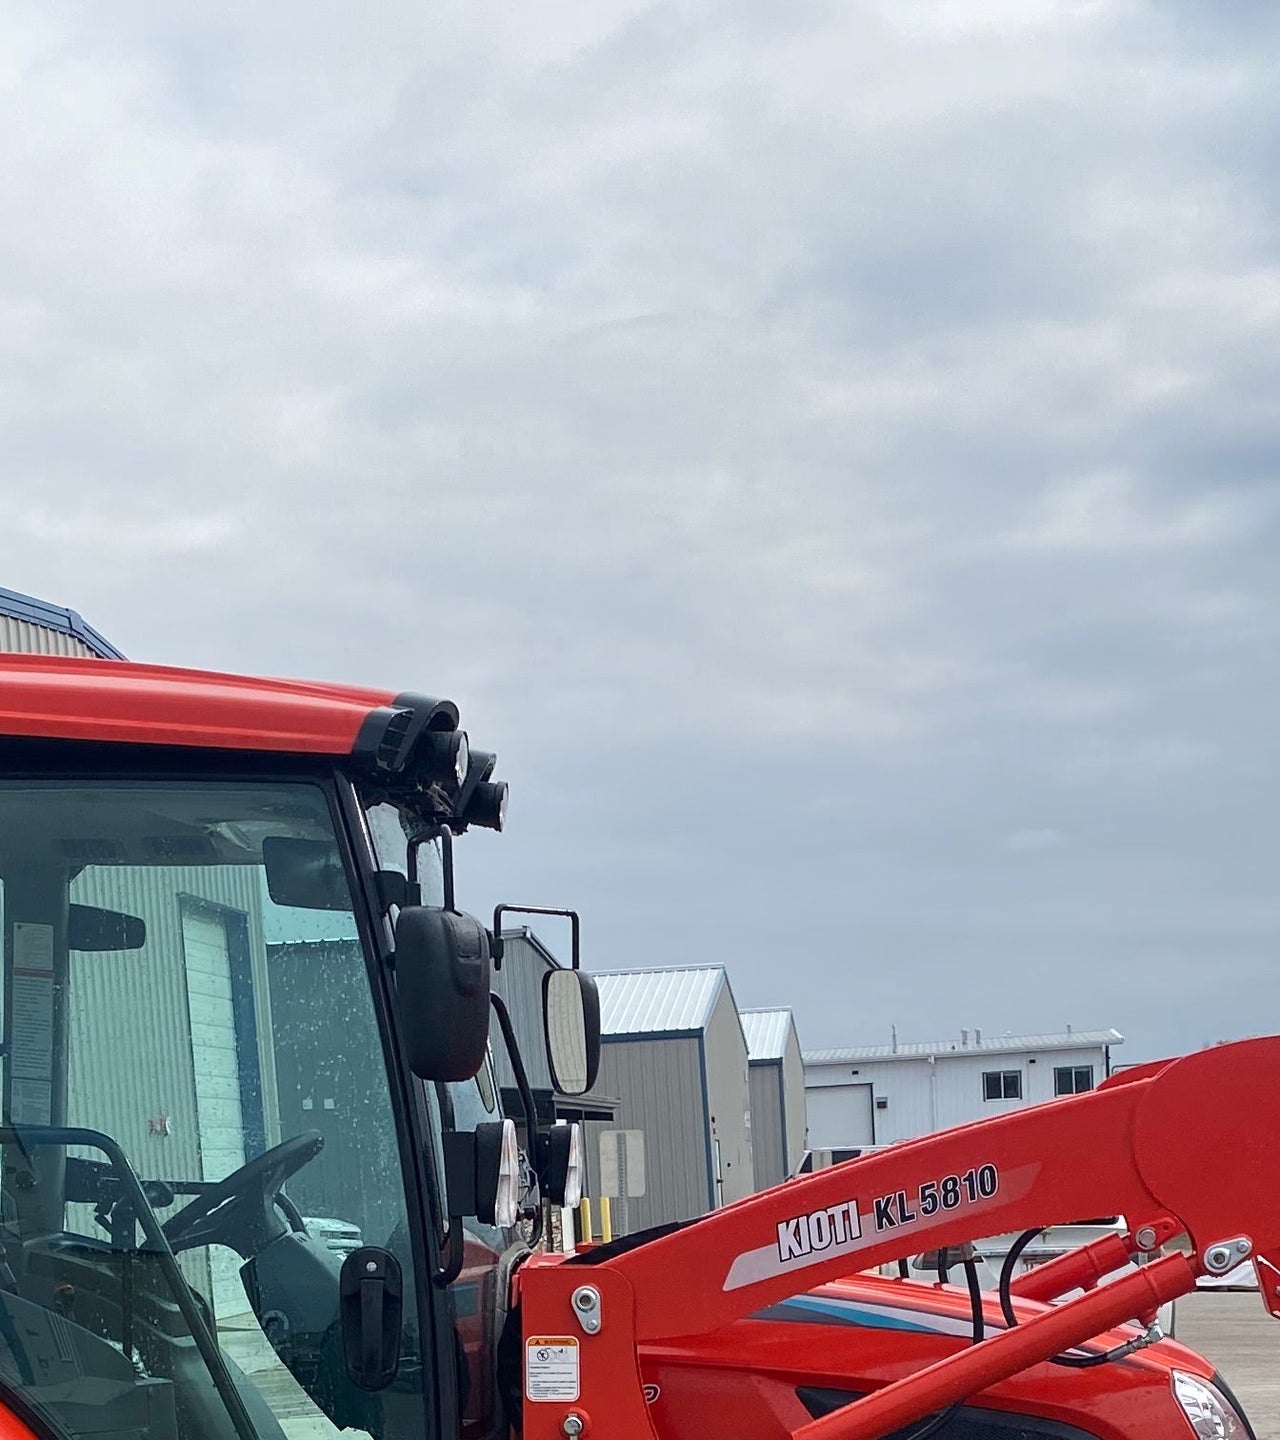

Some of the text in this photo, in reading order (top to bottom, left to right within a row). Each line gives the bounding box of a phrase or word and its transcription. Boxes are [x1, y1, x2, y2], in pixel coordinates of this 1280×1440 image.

[776, 1162, 999, 1263] KIOTI KL 5810
